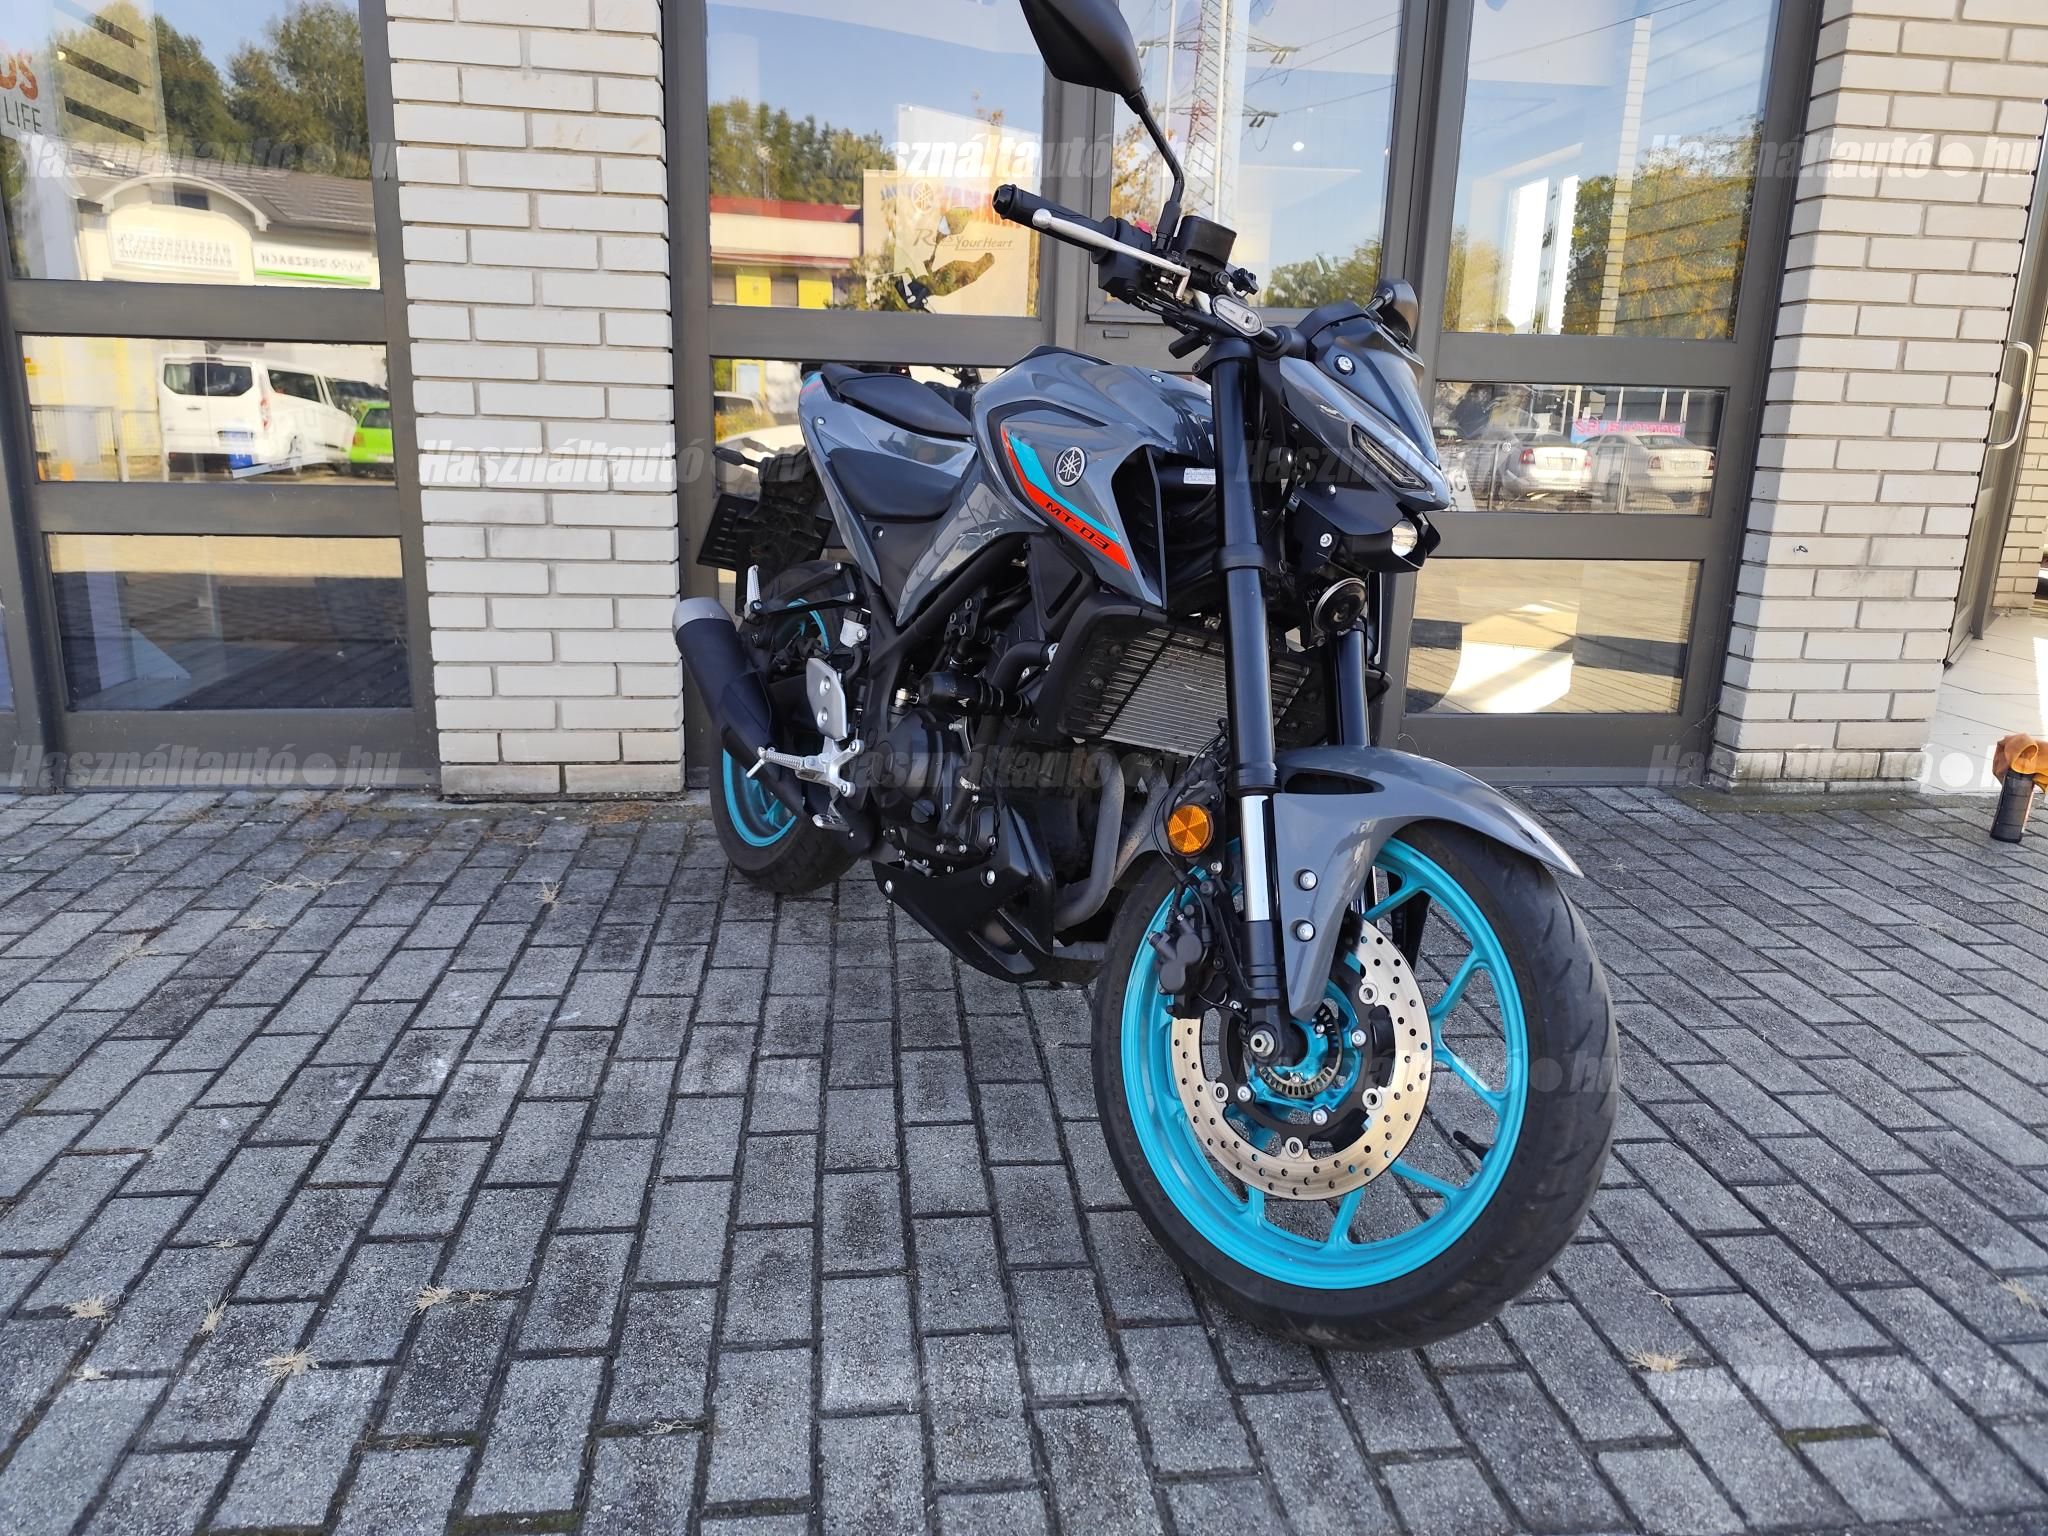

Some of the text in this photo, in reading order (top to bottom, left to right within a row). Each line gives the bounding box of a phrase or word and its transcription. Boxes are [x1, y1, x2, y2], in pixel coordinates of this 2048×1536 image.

[4, 95, 43, 136] LIFE
[983, 236, 1014, 249] Heart
[1045, 501, 1111, 551] MT-03
